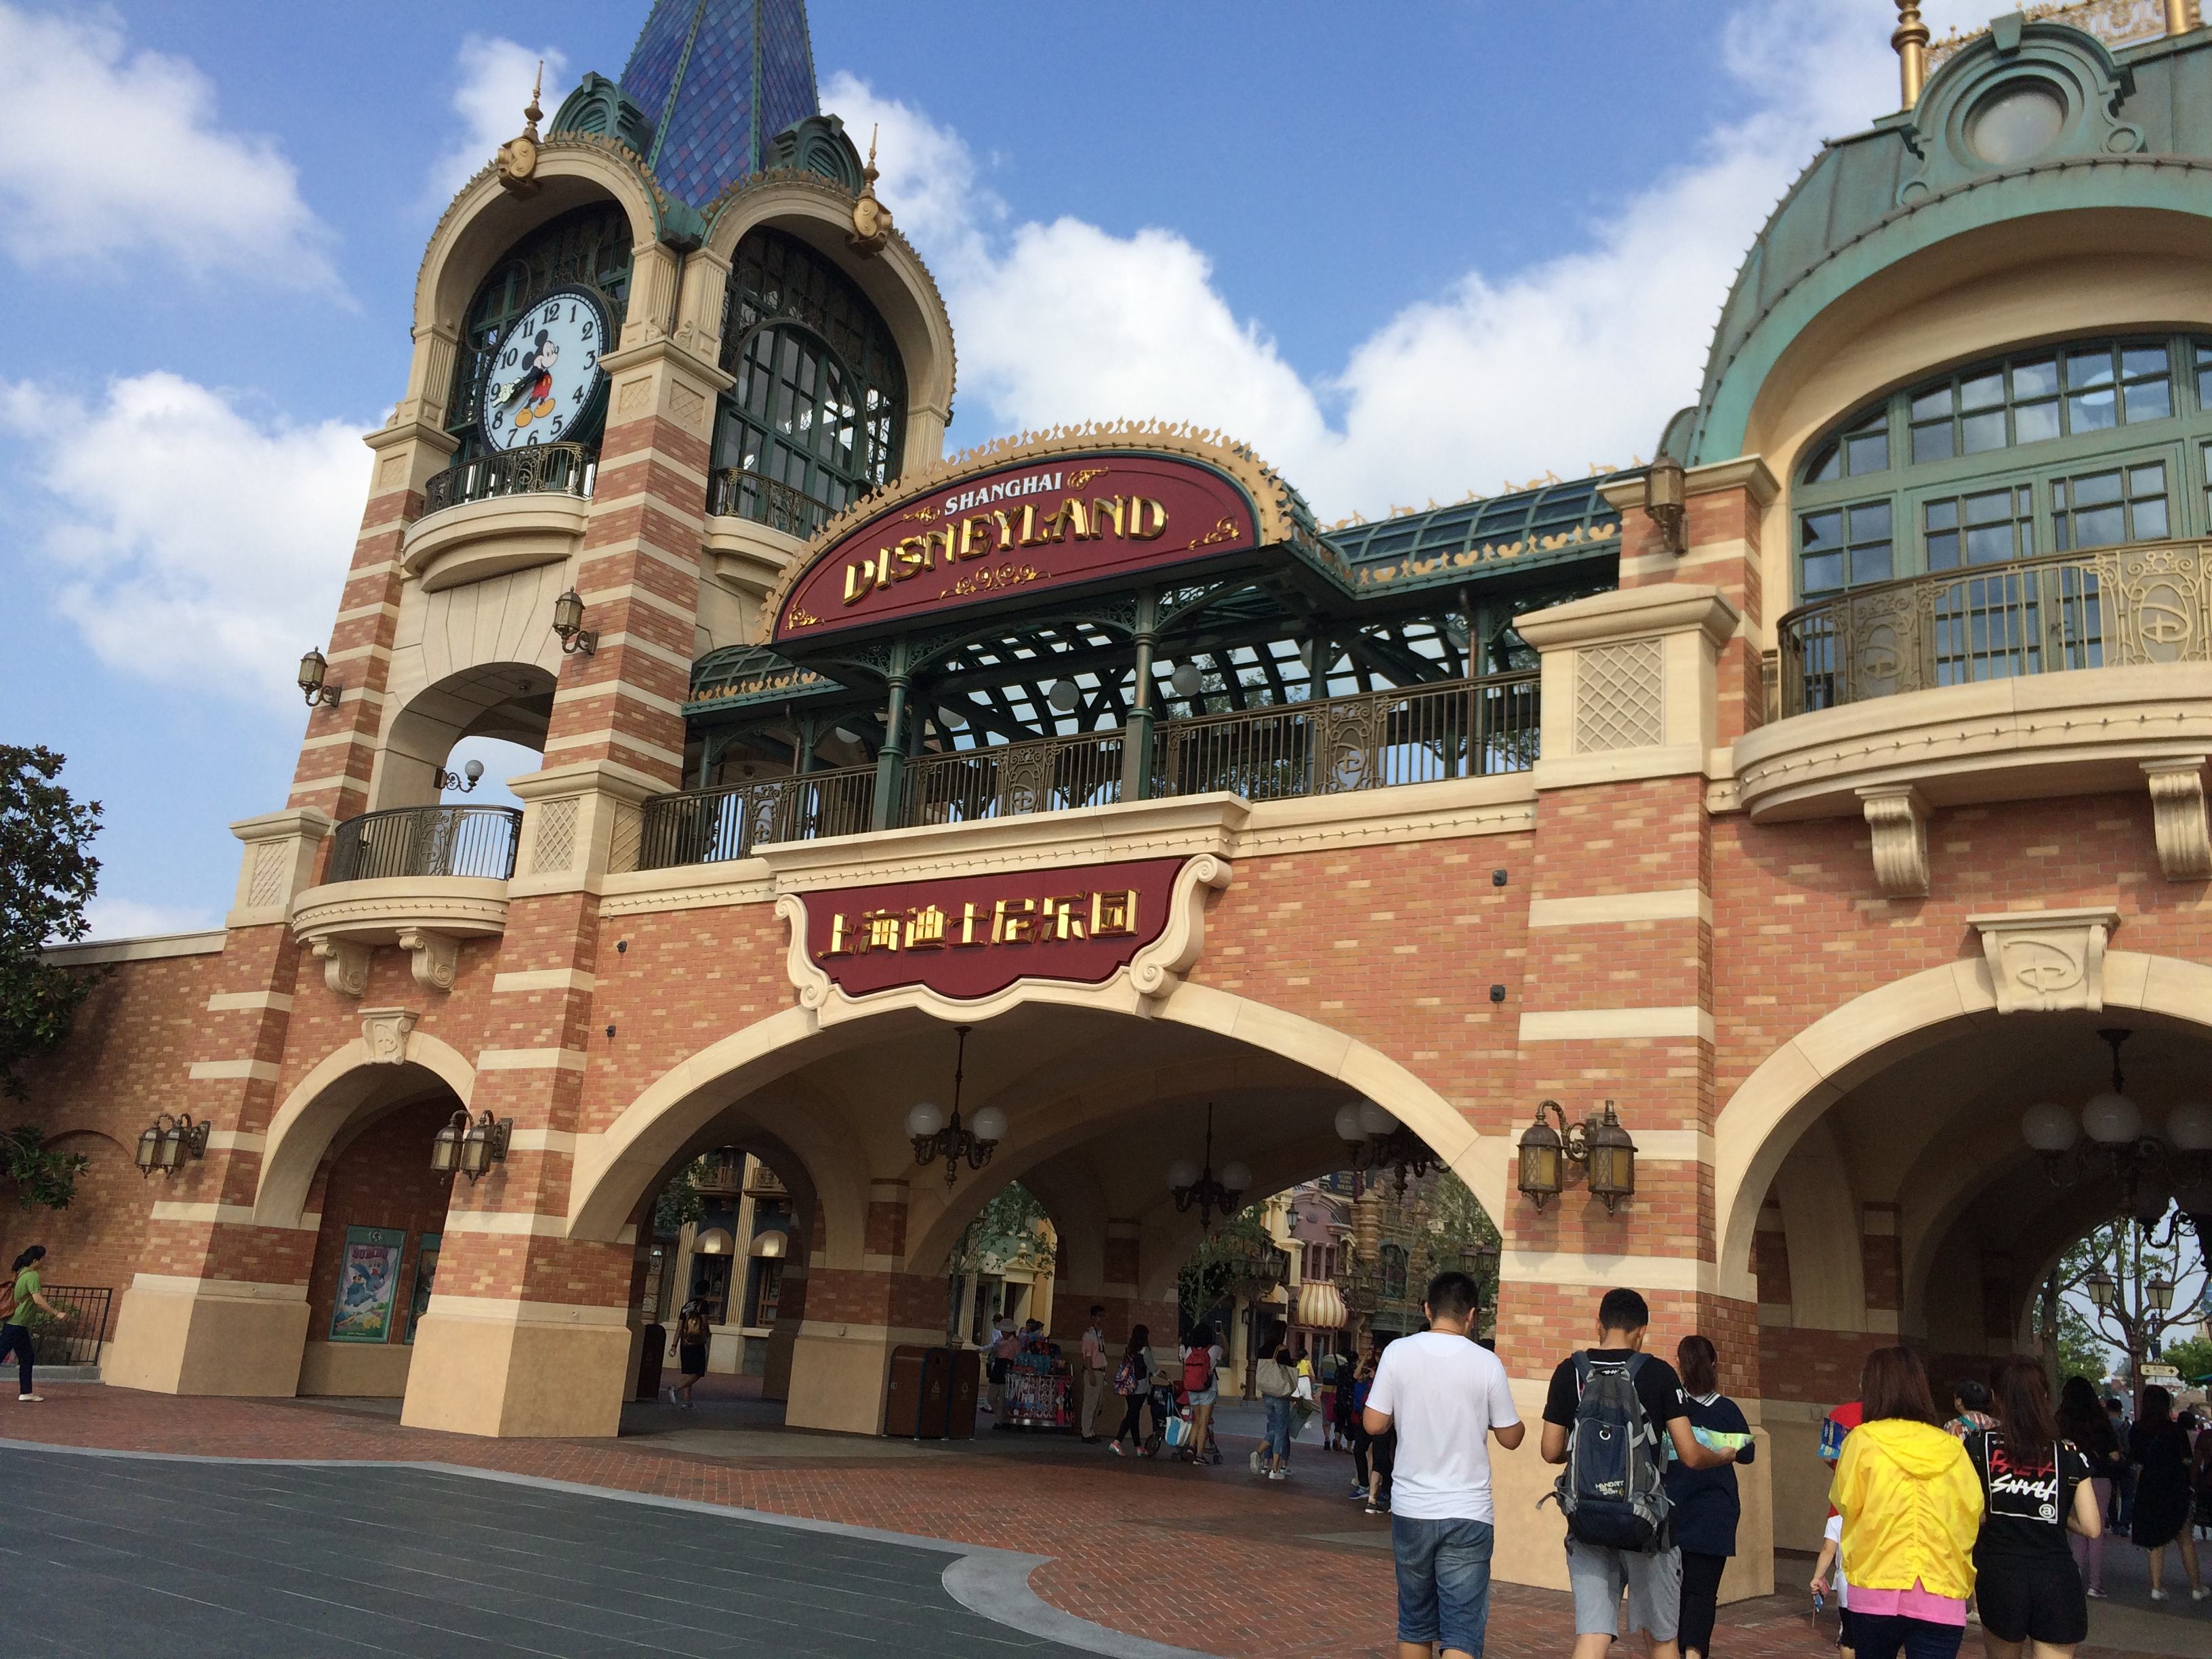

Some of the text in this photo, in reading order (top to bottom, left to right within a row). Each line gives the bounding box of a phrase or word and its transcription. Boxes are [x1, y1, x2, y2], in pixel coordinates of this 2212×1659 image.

[542, 302, 560, 325] 12
[569, 304, 577, 323] 1
[521, 319, 535, 339] 11
[581, 321, 594, 342] 2
[500, 348, 518, 370] 10
[583, 350, 596, 370] 3
[490, 382, 501, 402] 9
[572, 384, 584, 404] 4
[491, 411, 504, 430] 8
[550, 414, 563, 436] 5
[506, 428, 518, 448] 7
[527, 430, 539, 446] 6
[944, 471, 1063, 517] SHANGHAI
[842, 494, 1169, 607] DISNEYLAND
[815, 888, 1142, 960] 上海迪士尼乐园
